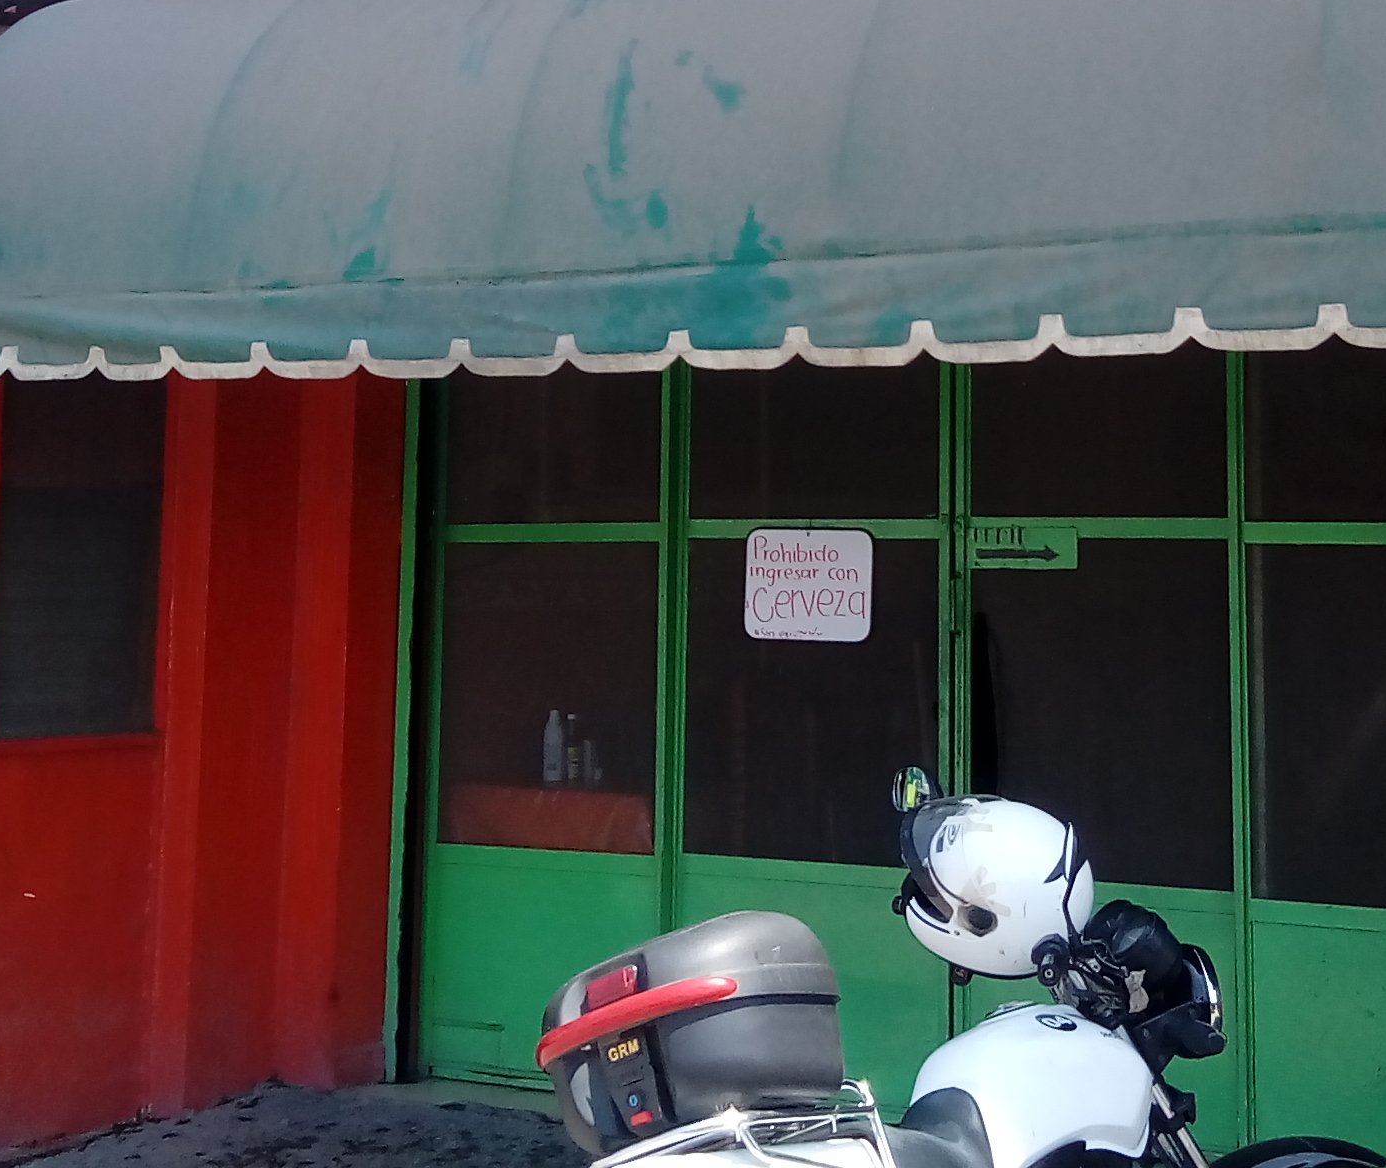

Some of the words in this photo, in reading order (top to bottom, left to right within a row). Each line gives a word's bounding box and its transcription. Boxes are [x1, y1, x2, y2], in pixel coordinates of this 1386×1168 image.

[754, 535, 839, 563] Prohibido
[750, 566, 819, 587] ingresar
[828, 567, 859, 583] con
[753, 587, 866, 622] Cerveza
[608, 1038, 640, 1062] GRM
